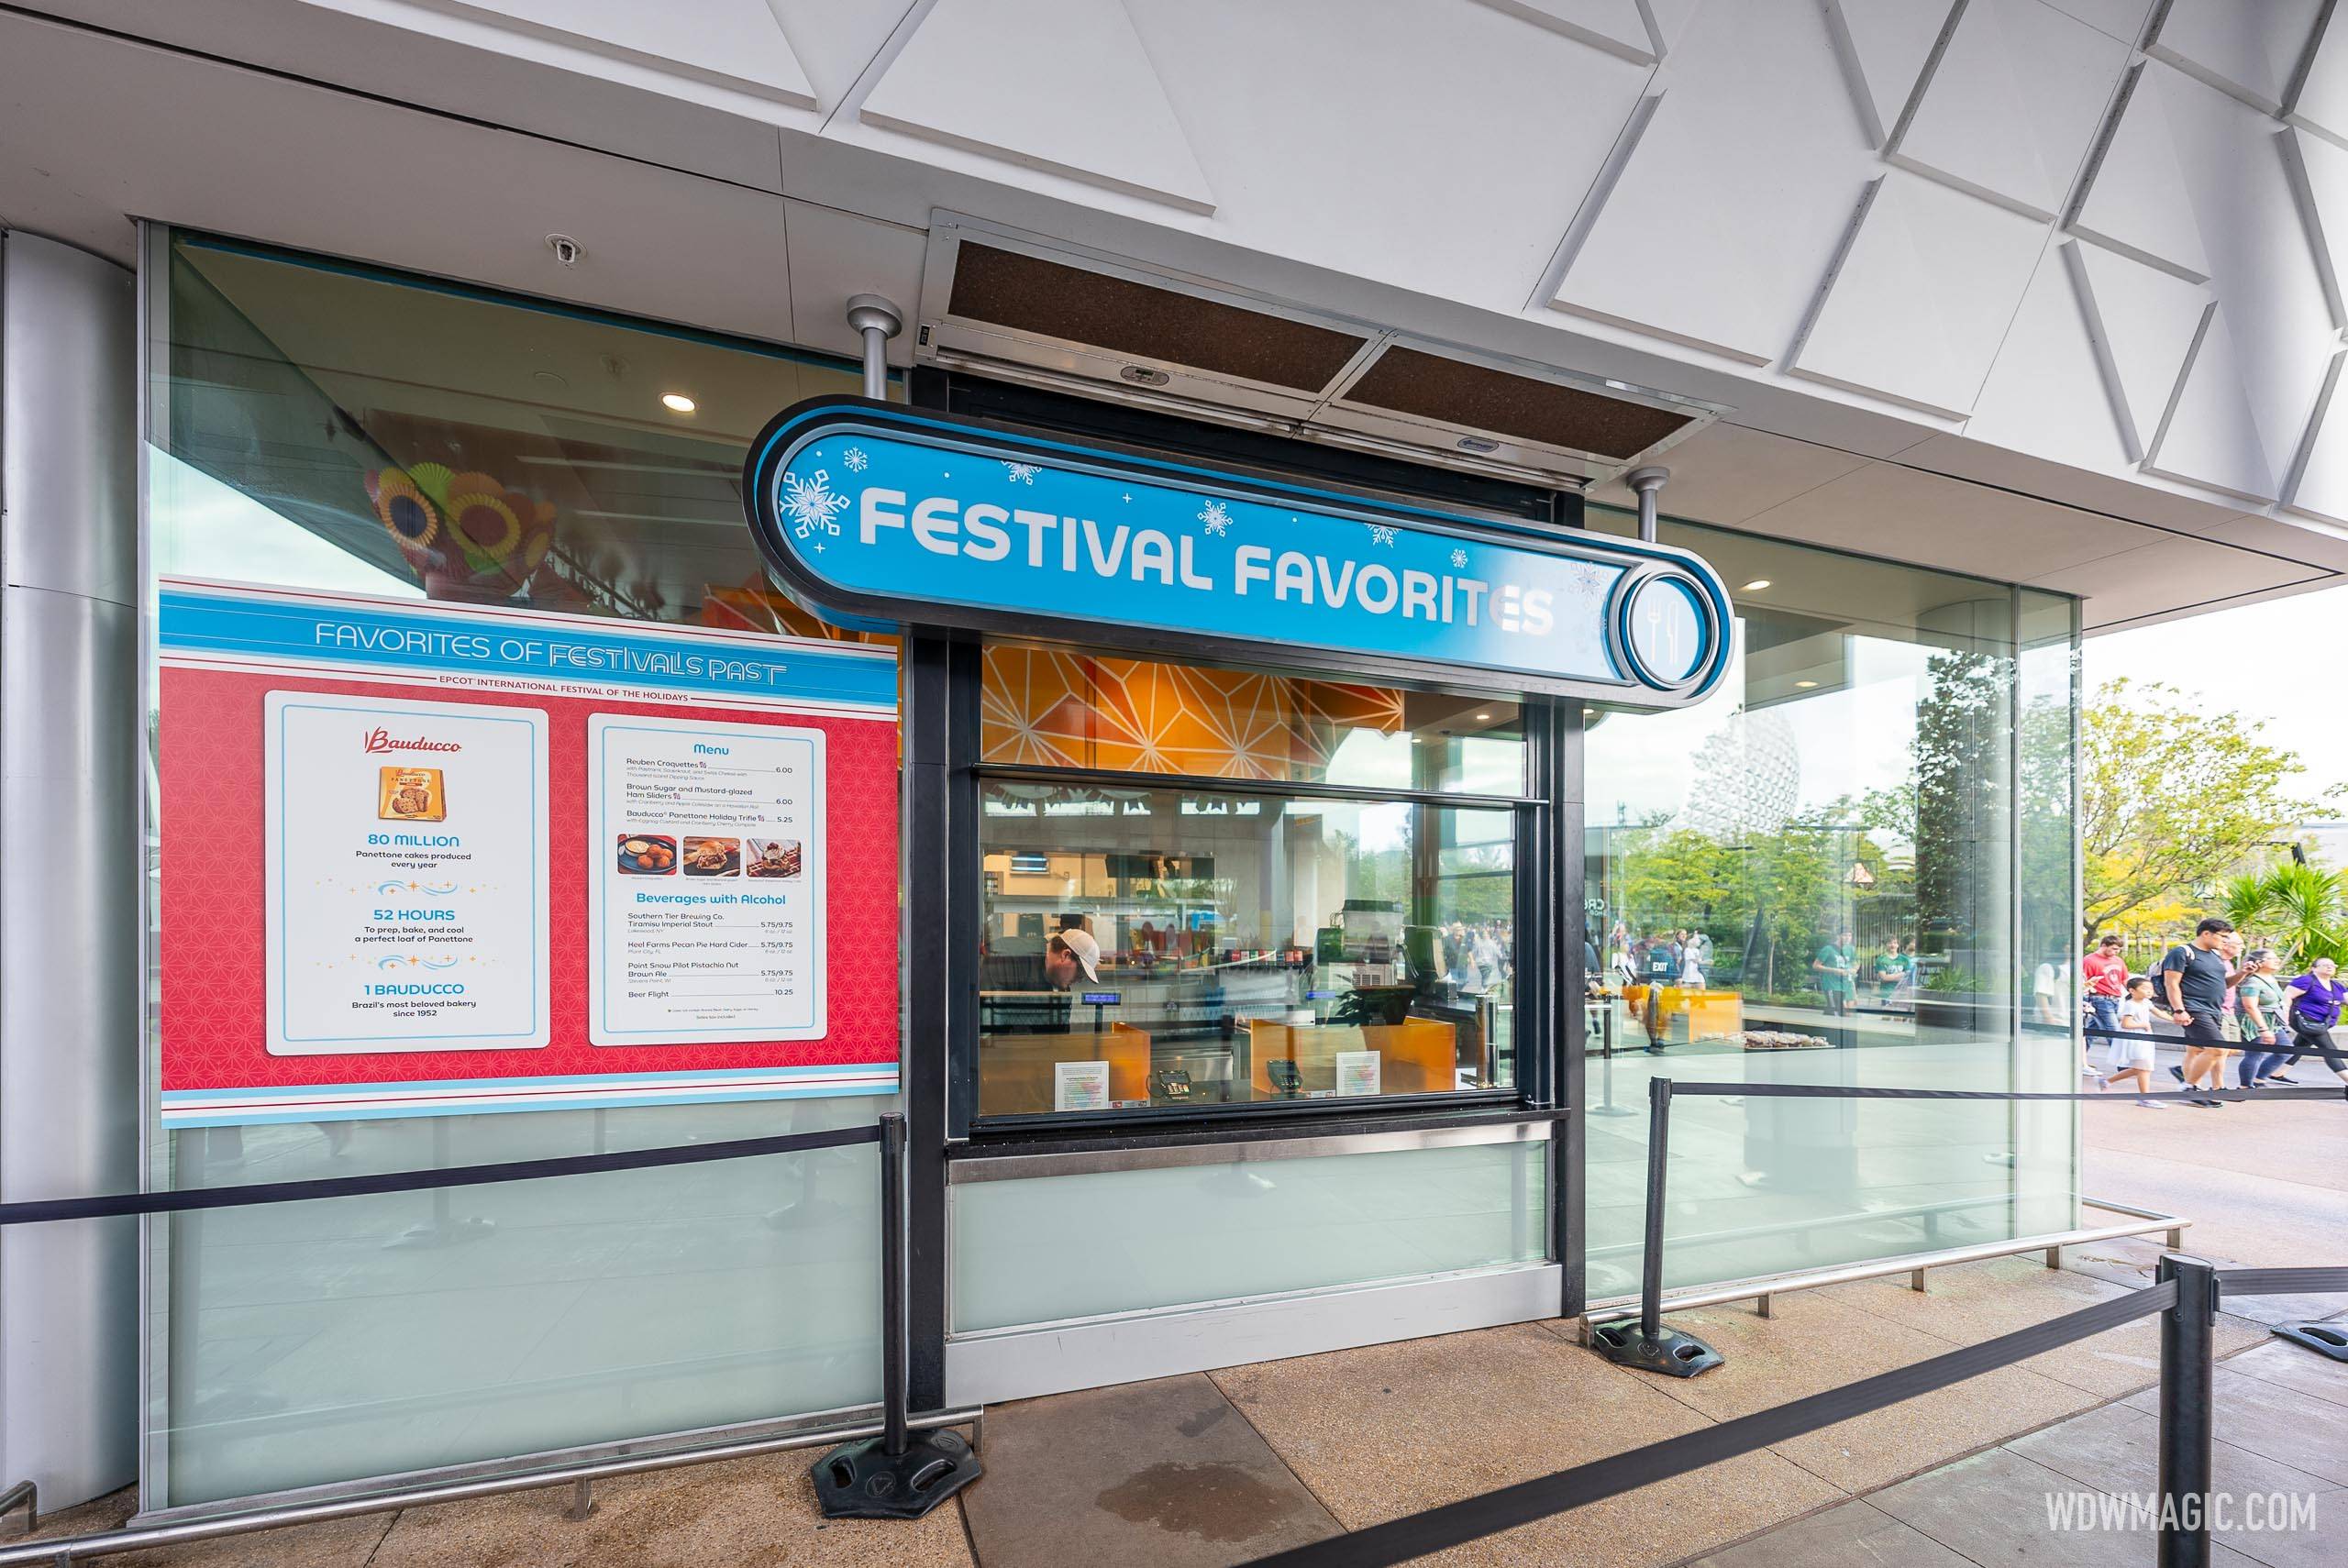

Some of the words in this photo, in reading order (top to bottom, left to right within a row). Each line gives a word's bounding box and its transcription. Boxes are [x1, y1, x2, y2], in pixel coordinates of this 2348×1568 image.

[860, 487, 1213, 591] FESTIVAL
[1235, 545, 1554, 636] FAVORITES
[316, 623, 491, 658] FAVORITES
[500, 640, 543, 662] OF
[549, 644, 703, 677] FESTIVALS
[708, 659, 787, 686] PAST
[477, 679, 558, 692] INTERNATIONAL
[560, 685, 604, 695] FESTIVAL
[624, 690, 640, 698] THE
[643, 691, 689, 701] HOLIDAYS
[364, 726, 462, 754] Bauducco
[693, 744, 729, 755] Menu
[657, 760, 698, 768] Croquettes
[695, 787, 752, 795] Mustard-glazed
[368, 834, 390, 845] 80
[394, 835, 460, 846] MILLION
[431, 853, 471, 863] produced
[637, 893, 706, 905] Beverages
[710, 894, 737, 904] with
[741, 895, 785, 904] Alcohol
[373, 910, 393, 920] 52
[398, 910, 455, 921] HOURS
[662, 921, 692, 929] Imperial
[363, 935, 395, 944] perfect
[1653, 962, 1667, 971] EXIT
[364, 985, 370, 995] 1
[375, 984, 464, 995] BAUDUCCO
[447, 1000, 476, 1009] bakery
